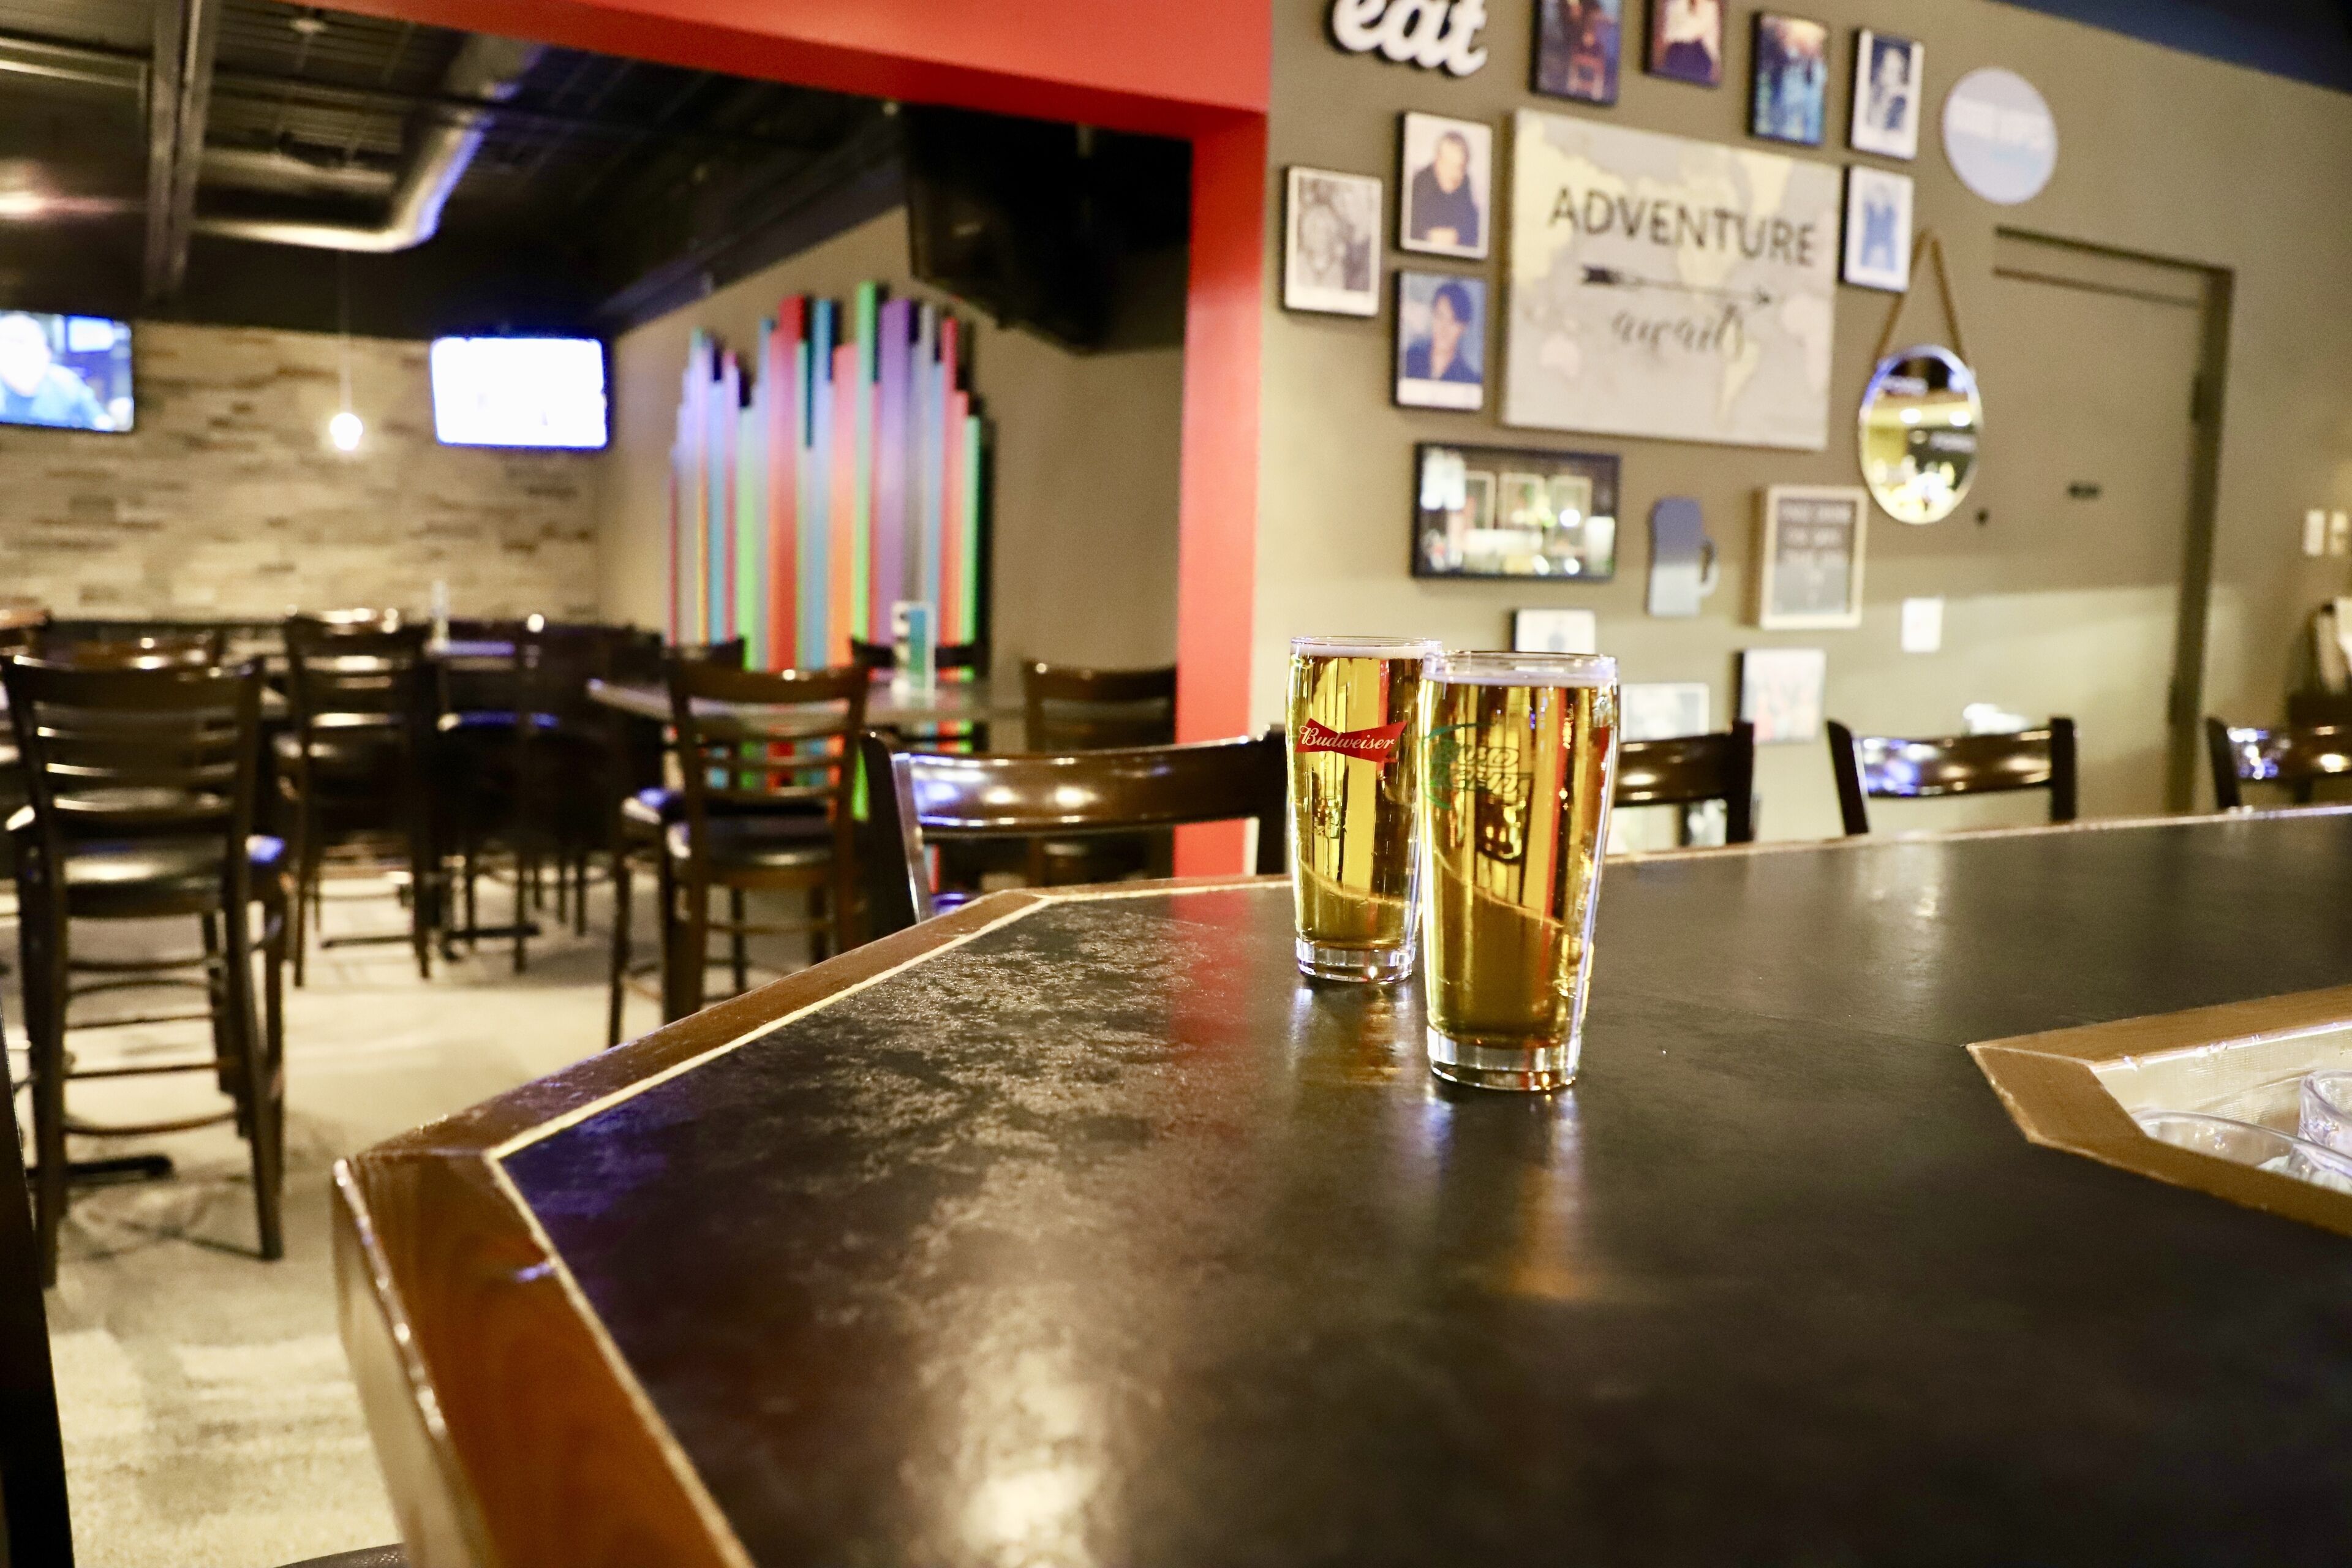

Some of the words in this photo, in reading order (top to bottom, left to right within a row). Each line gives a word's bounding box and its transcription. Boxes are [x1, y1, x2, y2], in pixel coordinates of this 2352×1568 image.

[1332, 0, 1488, 77] eat
[1548, 186, 1815, 268] ADVENTURE
[1299, 725, 1395, 749] Budweiser
